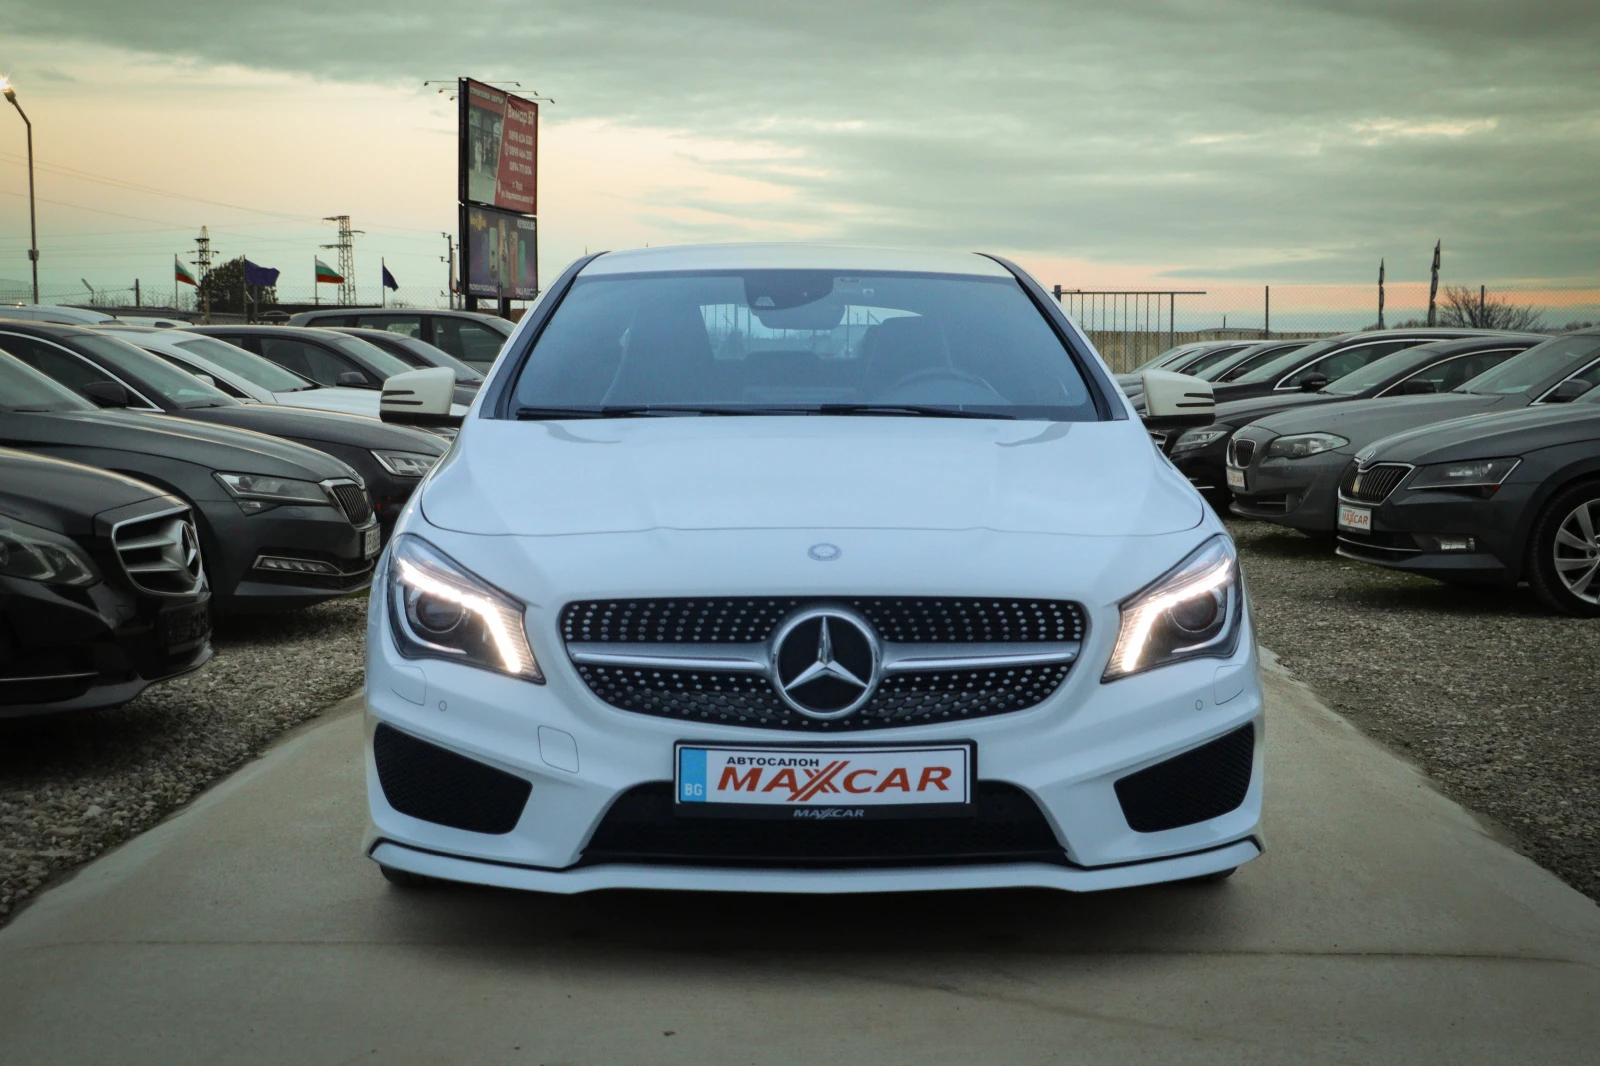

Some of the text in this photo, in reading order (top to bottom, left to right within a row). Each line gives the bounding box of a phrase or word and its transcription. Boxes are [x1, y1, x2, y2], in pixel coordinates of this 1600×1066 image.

[727, 756, 819, 767] АВТОСАЛОН
[717, 760, 952, 802] MAXCAR
[684, 783, 703, 796] BG
